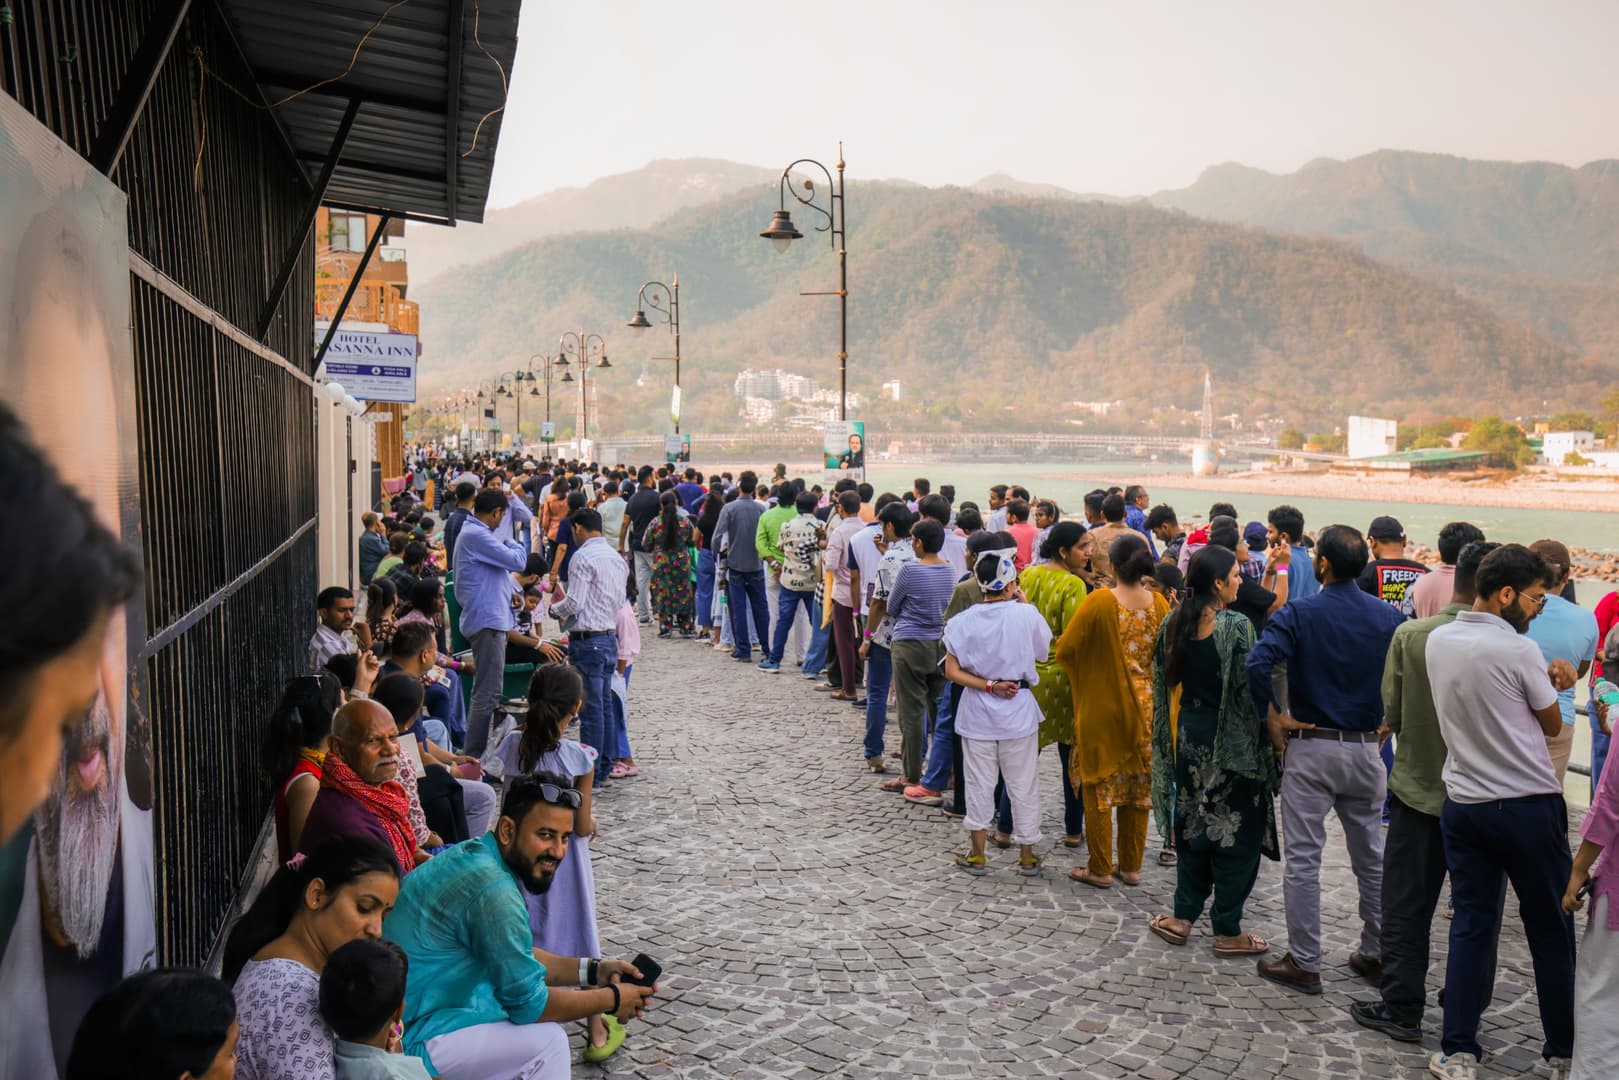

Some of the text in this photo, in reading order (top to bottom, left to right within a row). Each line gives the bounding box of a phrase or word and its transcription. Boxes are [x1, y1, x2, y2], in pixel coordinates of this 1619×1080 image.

[340, 334, 380, 344] HOTEL
[328, 344, 413, 356] ASANNA INN
[1382, 583, 1406, 592] BEGINS
